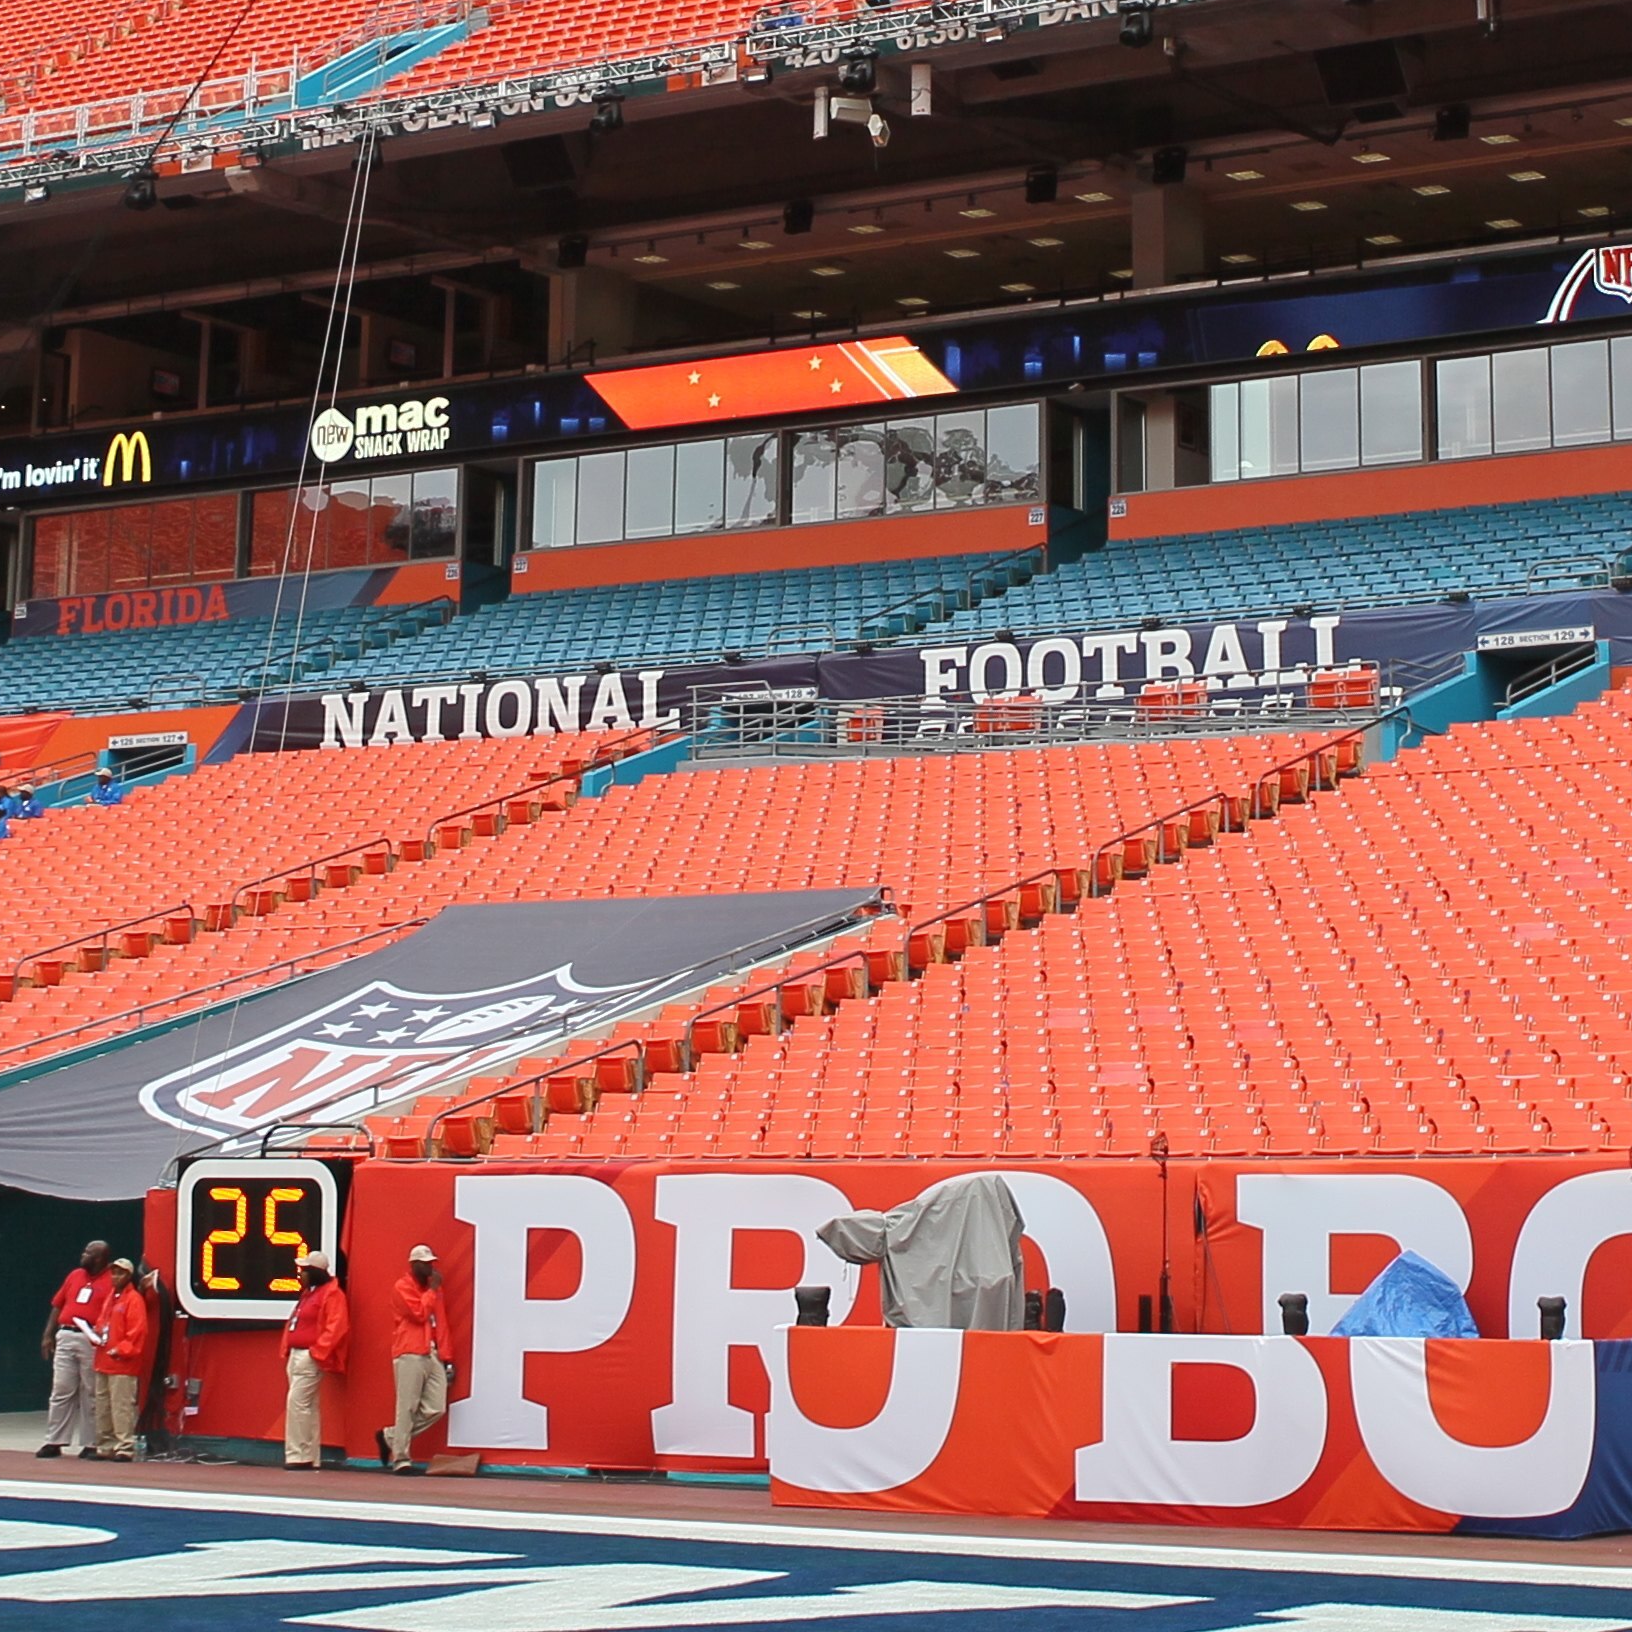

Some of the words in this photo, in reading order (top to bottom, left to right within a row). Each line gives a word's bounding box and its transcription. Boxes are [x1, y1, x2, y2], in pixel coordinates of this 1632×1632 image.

[317, 425, 350, 446] new
[355, 396, 450, 436] mac
[354, 432, 403, 460] SNACK
[406, 427, 451, 453] WRAP
[83, 456, 101, 481] it
[57, 584, 230, 635] FLORIDA
[920, 615, 1362, 708] FOOTBALL
[1494, 636, 1515, 647] 128
[1519, 633, 1551, 644] SECTION
[1554, 630, 1576, 642] 129
[320, 669, 682, 750] NATIONAL
[785, 689, 803, 700] 128
[202, 1187, 310, 1293] 25
